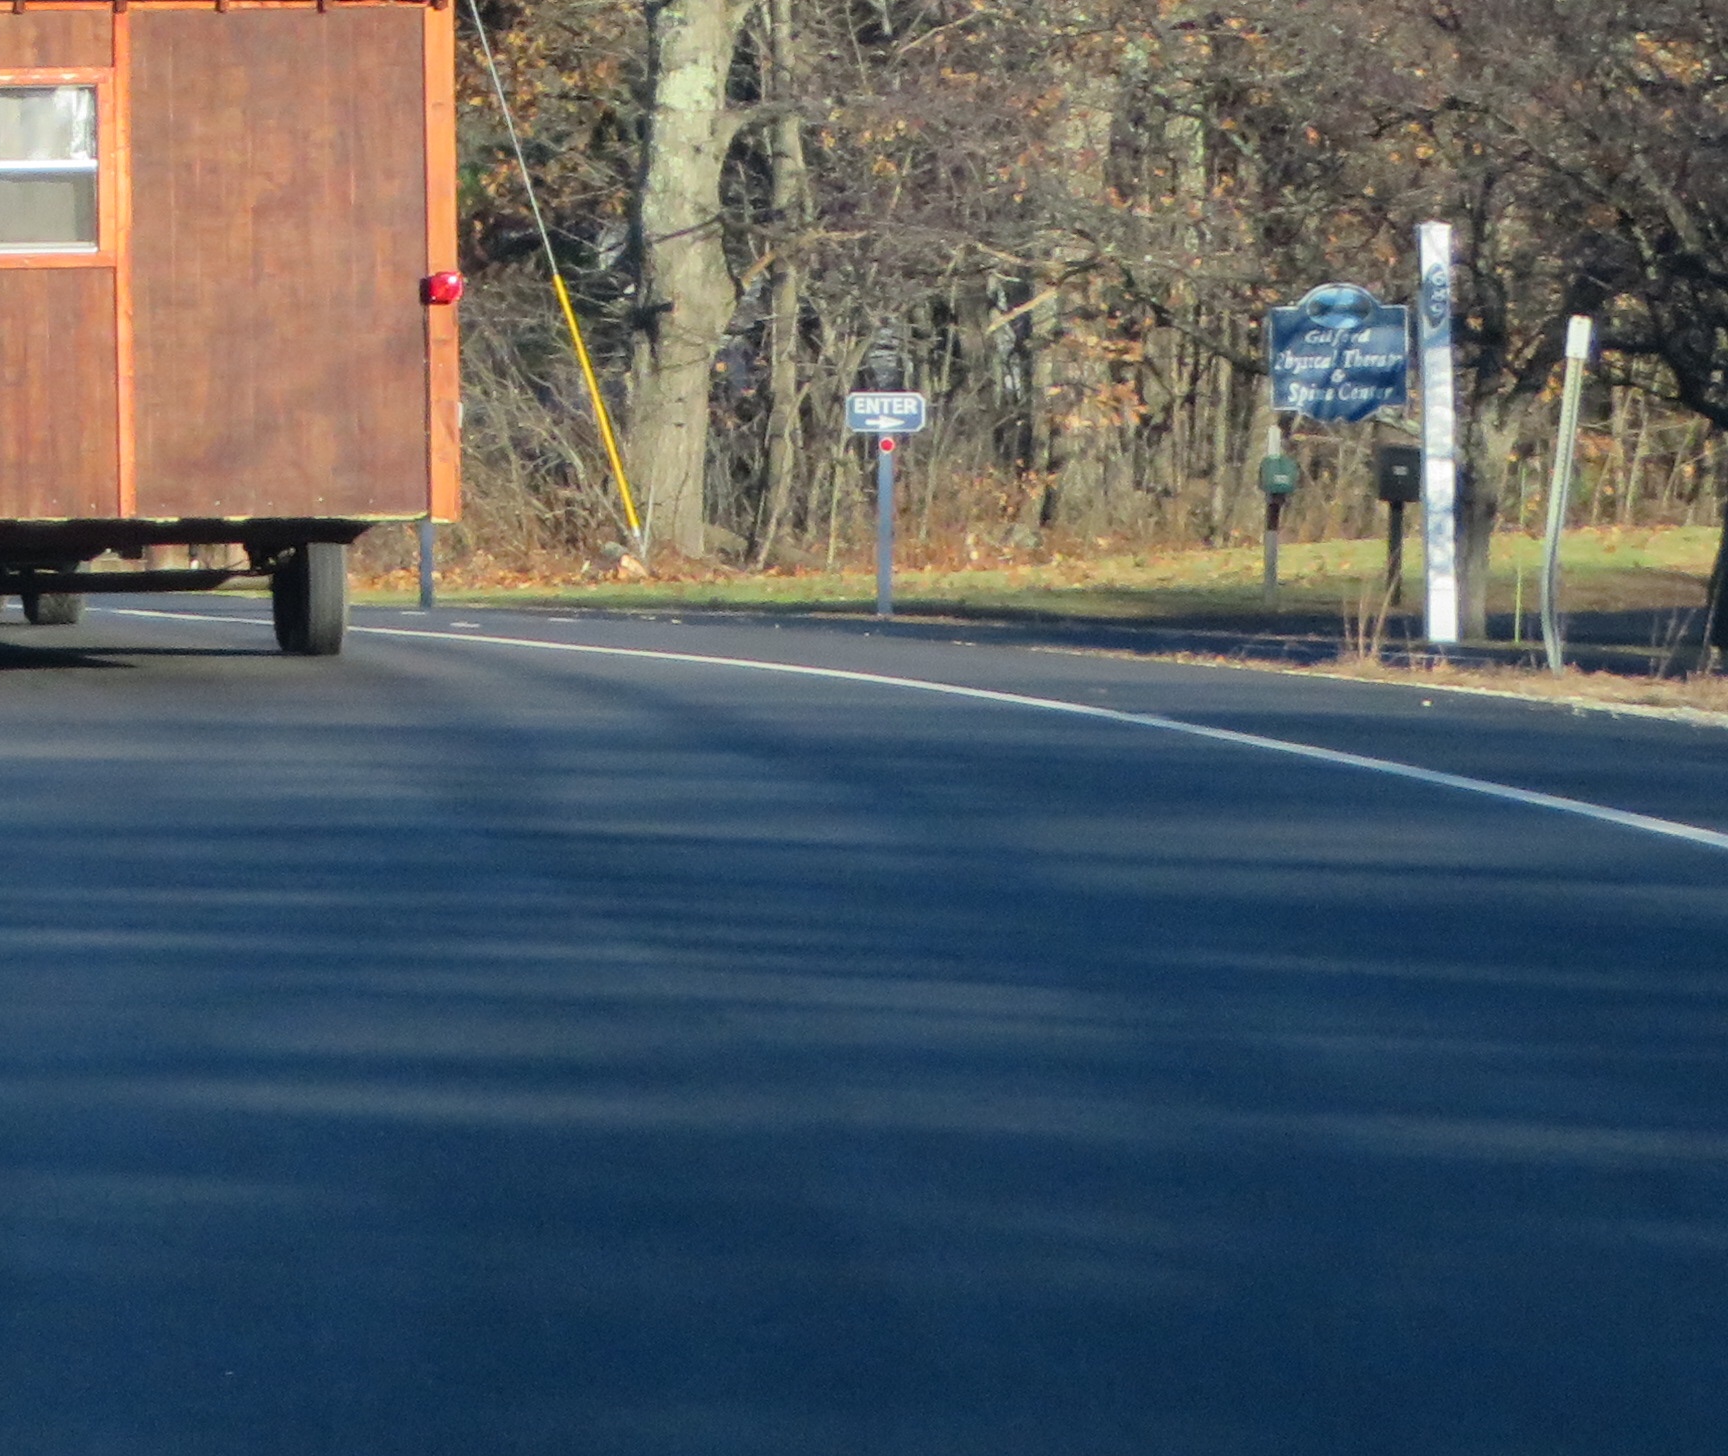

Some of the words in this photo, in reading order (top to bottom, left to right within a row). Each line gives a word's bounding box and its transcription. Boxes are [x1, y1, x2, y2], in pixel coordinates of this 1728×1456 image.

[1305, 328, 1372, 347] Gilford
[1274, 348, 1338, 374] Physical
[1330, 369, 1345, 383] &
[1287, 382, 1335, 407] Spine
[1338, 382, 1395, 402] Center
[854, 397, 918, 415] ENTER
